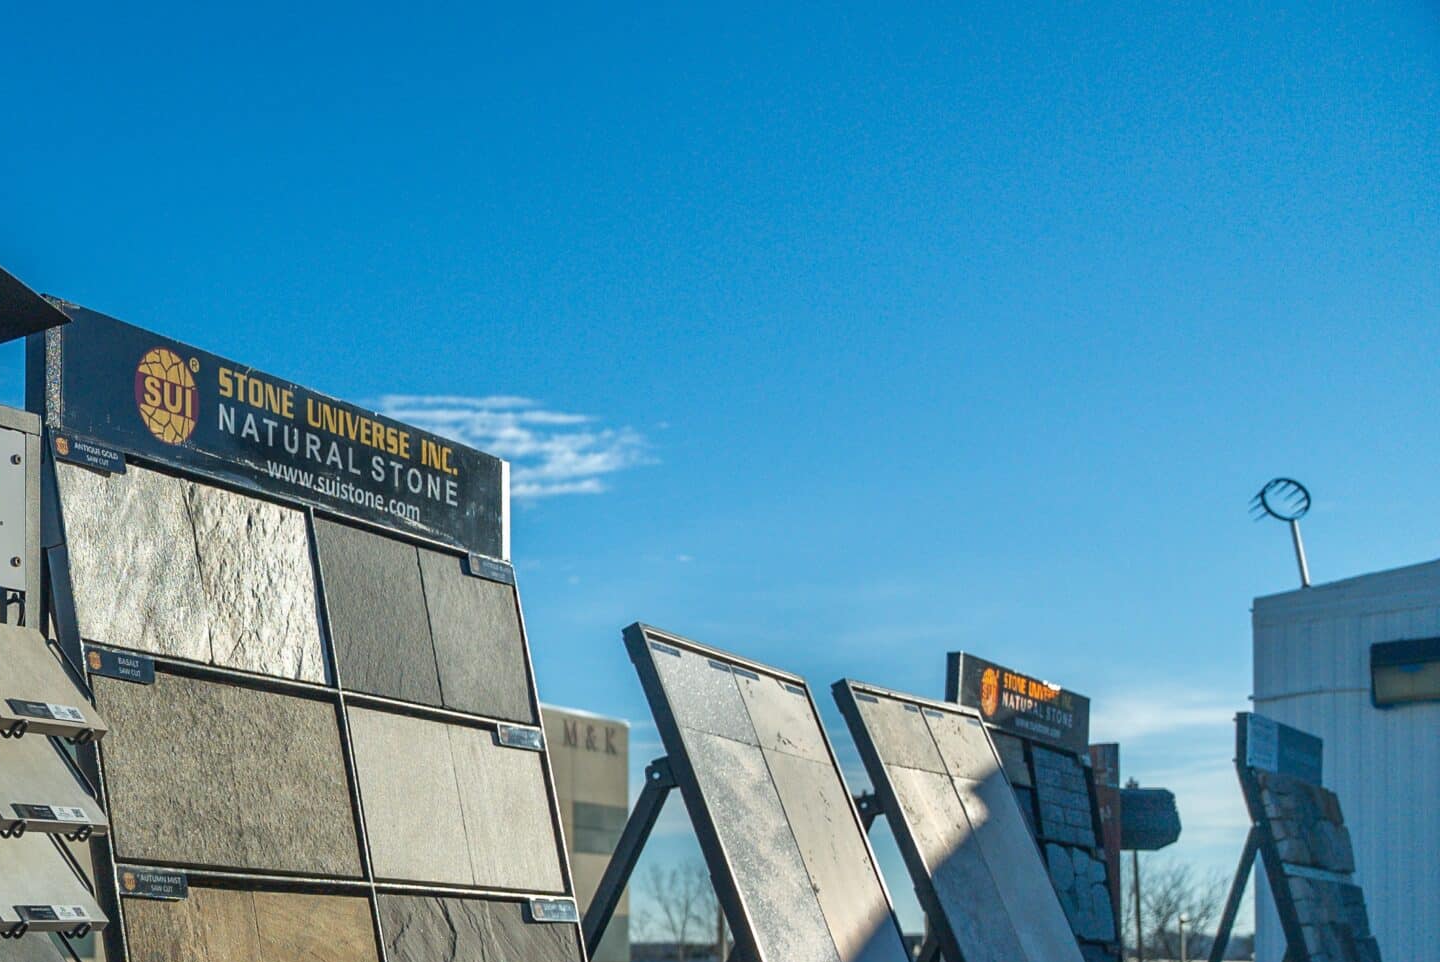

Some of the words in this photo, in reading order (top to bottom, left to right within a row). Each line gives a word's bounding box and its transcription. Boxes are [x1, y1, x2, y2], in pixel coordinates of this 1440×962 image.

[143, 375, 192, 418] SUI
[218, 366, 294, 420] STONE
[306, 398, 410, 459] UNIVERSE
[420, 440, 459, 475] INC.
[218, 403, 361, 475] NATURAL
[371, 455, 459, 507] STONE
[266, 459, 420, 522] www.suistone.com
[1002, 691, 1044, 718] NATURAL
[1046, 706, 1073, 728] STONE
[1004, 672, 1026, 695] STONE
